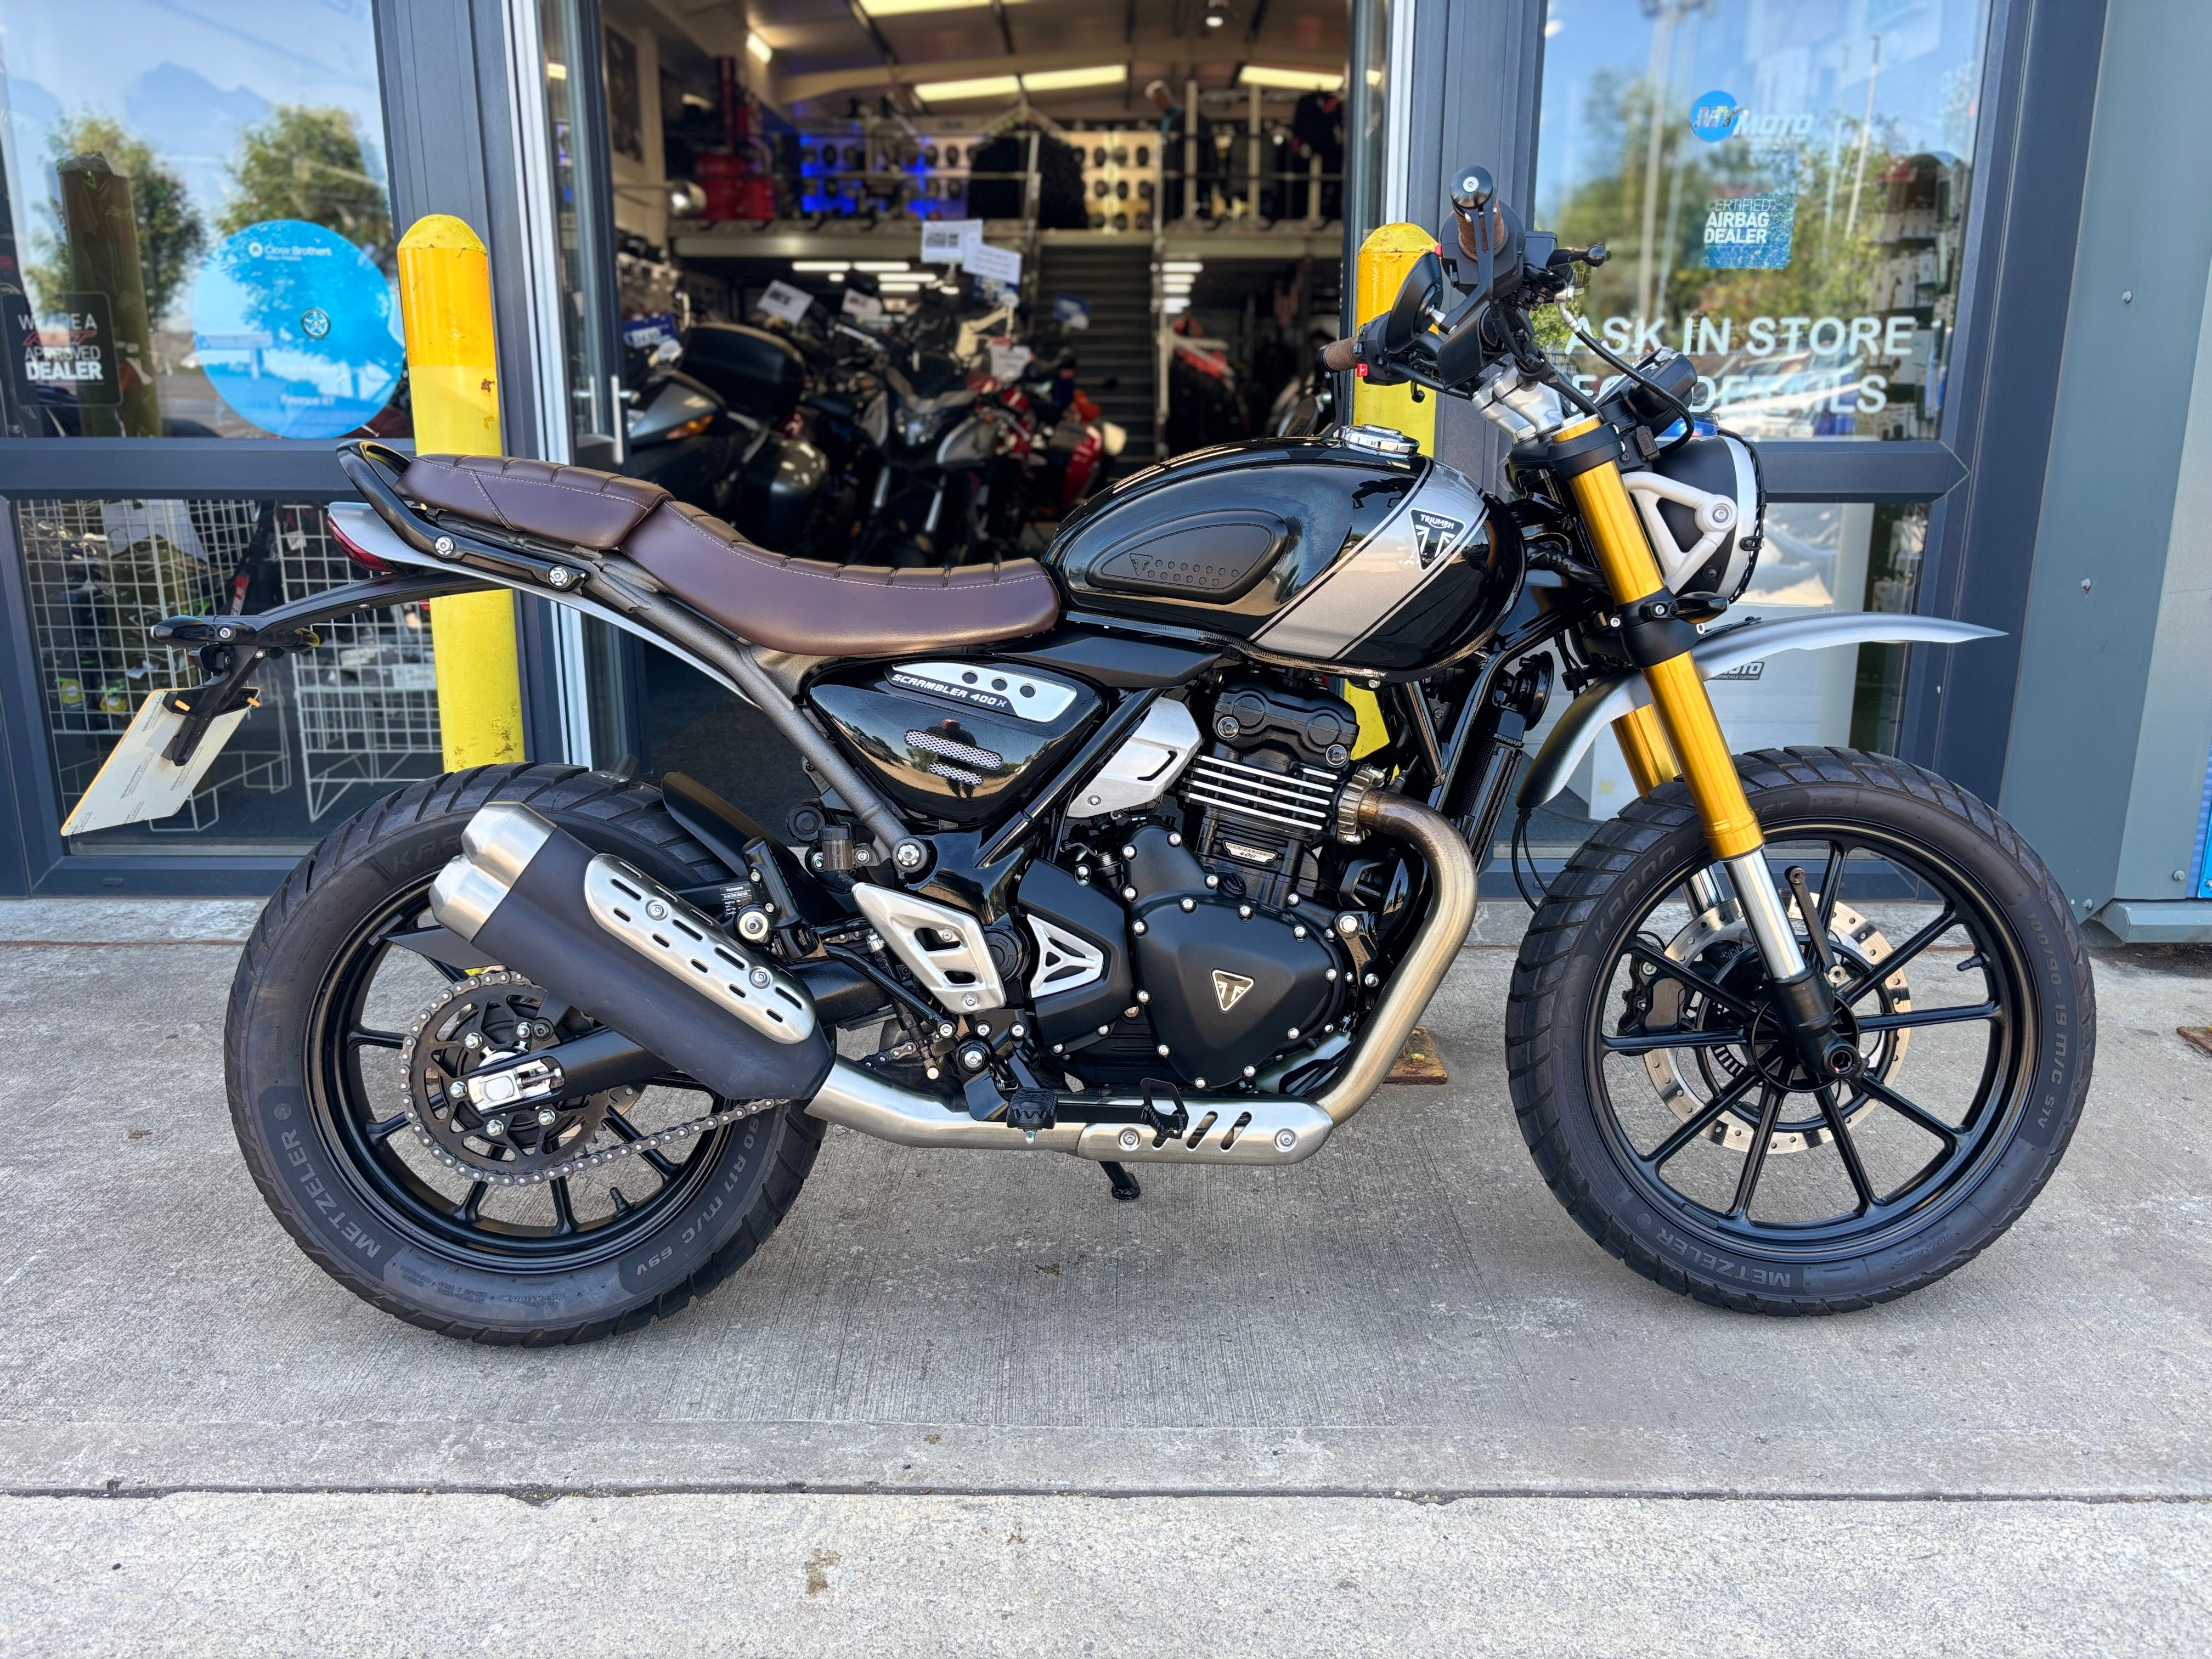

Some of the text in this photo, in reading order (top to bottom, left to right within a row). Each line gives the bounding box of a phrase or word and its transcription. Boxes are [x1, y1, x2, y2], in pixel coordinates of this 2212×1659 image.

[1708, 198, 1771, 212] CERTIFIED
[1705, 211, 1770, 228] AIRBAG
[1703, 228, 1768, 244] DEALER
[84, 313, 98, 330] A
[1565, 316, 1916, 356] ASK IN STORE
[25, 360, 104, 381] DEALER
[1420, 514, 1455, 529] TRIUMPH
[891, 674, 968, 698] SCRAMBLER
[724, 1154, 747, 1194] R17
[280, 1128, 382, 1259] METZELER
[636, 1245, 673, 1276] 69V
[1656, 1227, 1791, 1288] METZELER
